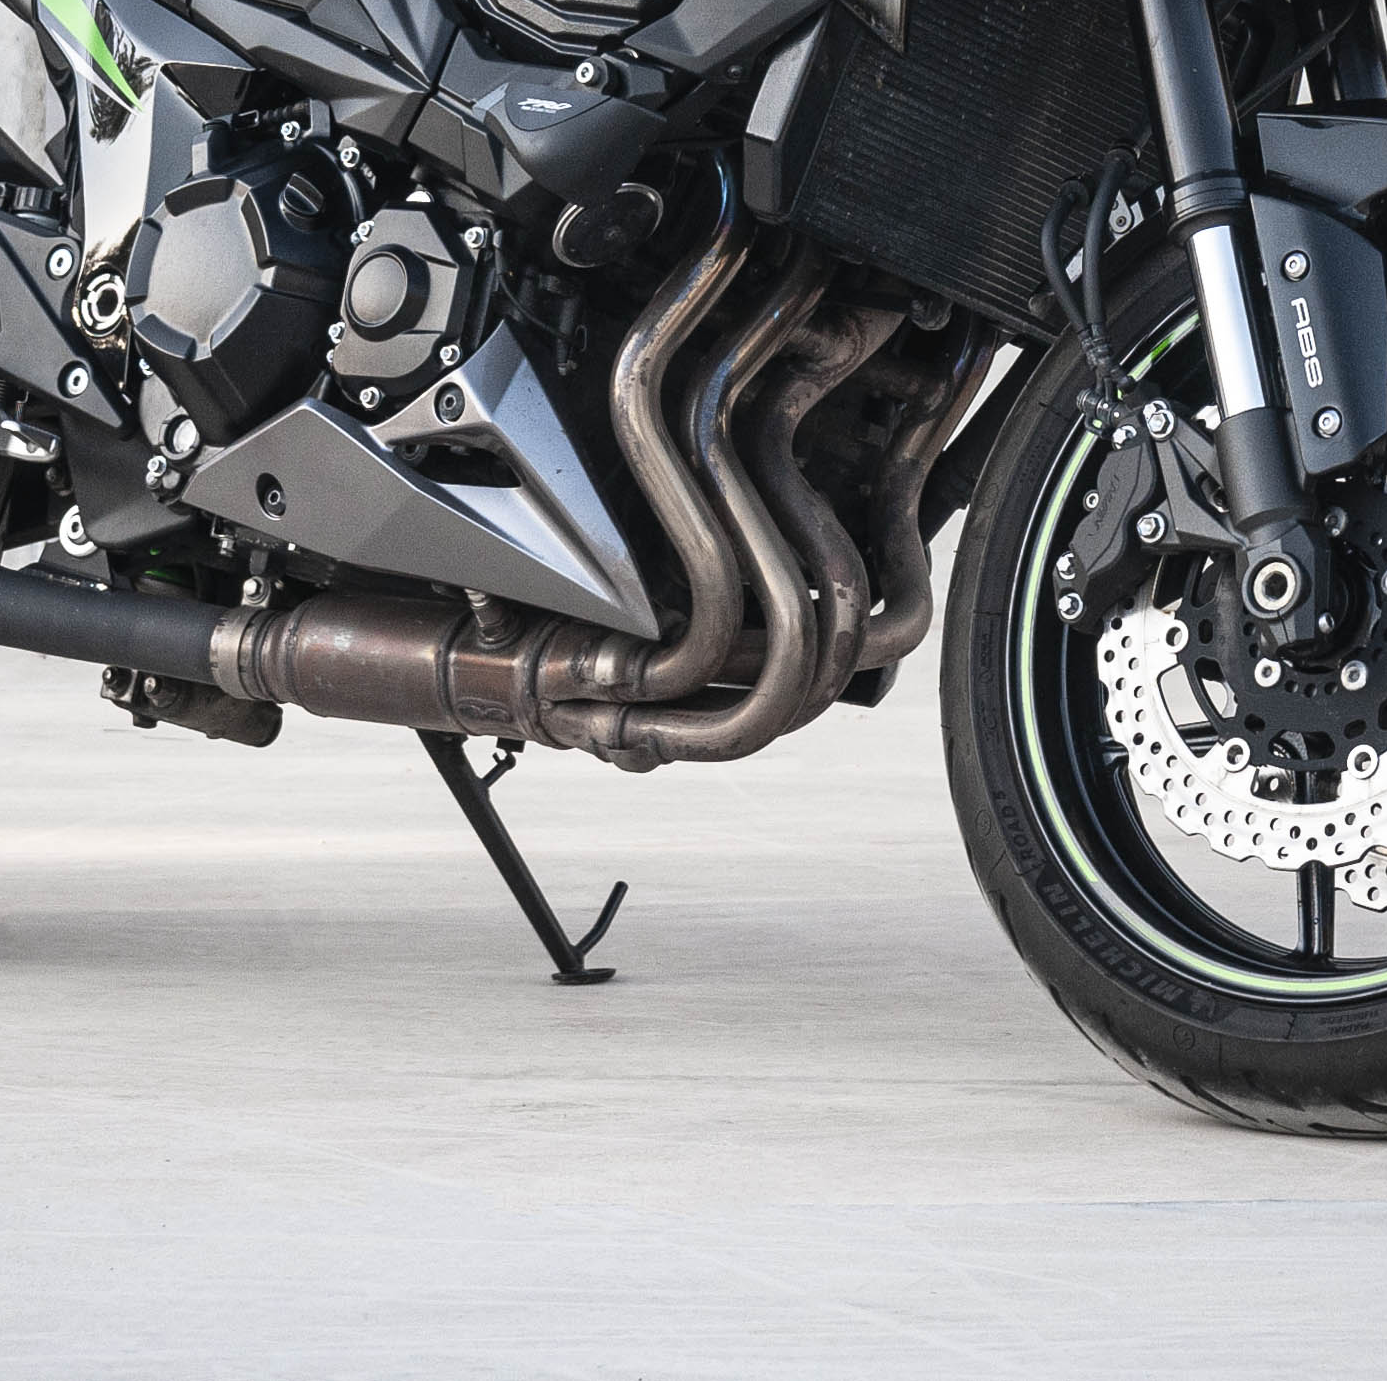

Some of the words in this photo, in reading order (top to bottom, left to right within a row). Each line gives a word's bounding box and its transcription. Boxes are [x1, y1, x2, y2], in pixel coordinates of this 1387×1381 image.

[1290, 297, 1324, 389] ABS
[1001, 805, 1037, 860] ROAD
[1042, 882, 1184, 1003] MICHELIN
